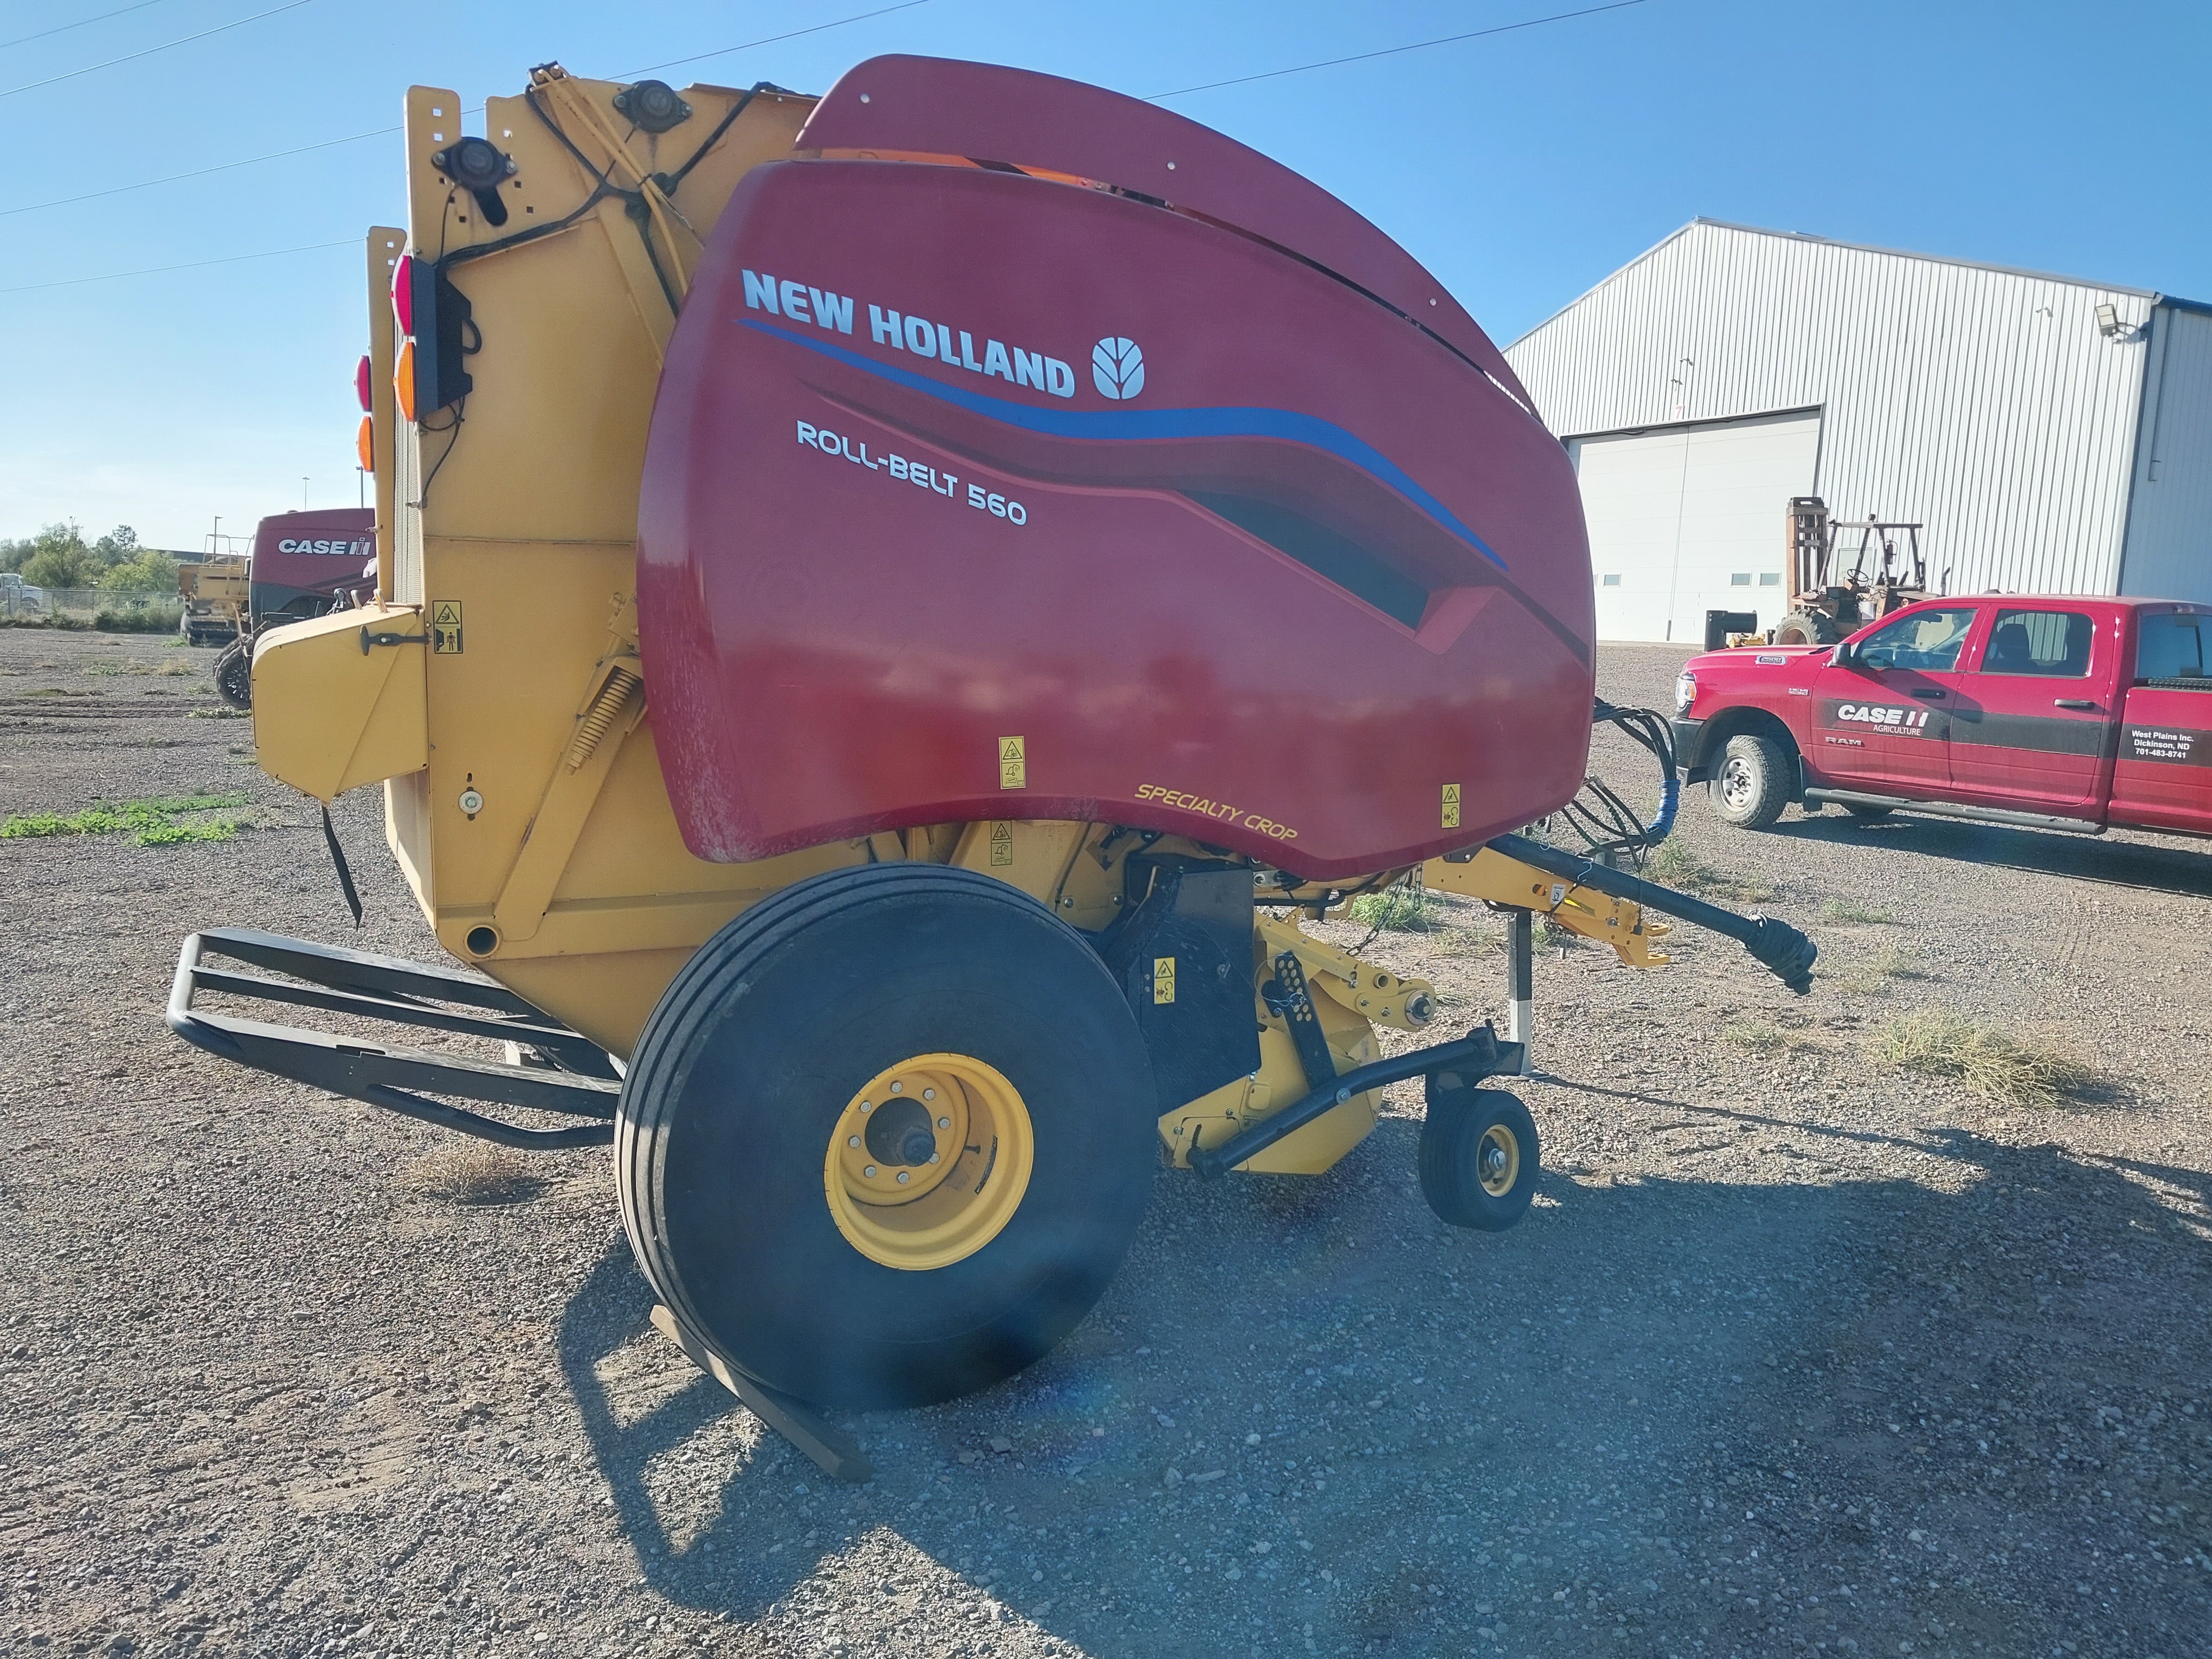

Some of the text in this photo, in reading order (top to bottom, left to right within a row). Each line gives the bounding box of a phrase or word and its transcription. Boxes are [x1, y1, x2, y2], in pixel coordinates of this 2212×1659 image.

[741, 269, 1076, 398] NEW HOLLAND
[796, 420, 1027, 526] ROLL-BELT 560
[278, 539, 347, 555] CASE
[1838, 705, 1904, 725] CASE
[1873, 724, 1921, 736] AGRICULTURE
[2132, 730, 2194, 742] West Plains Inc.
[1825, 737, 1862, 747] RAM
[2133, 739, 2190, 750] Dickinson, ND
[2135, 748, 2187, 759] 701-483-8741
[1134, 783, 1298, 840] SPECIALTY CROP
